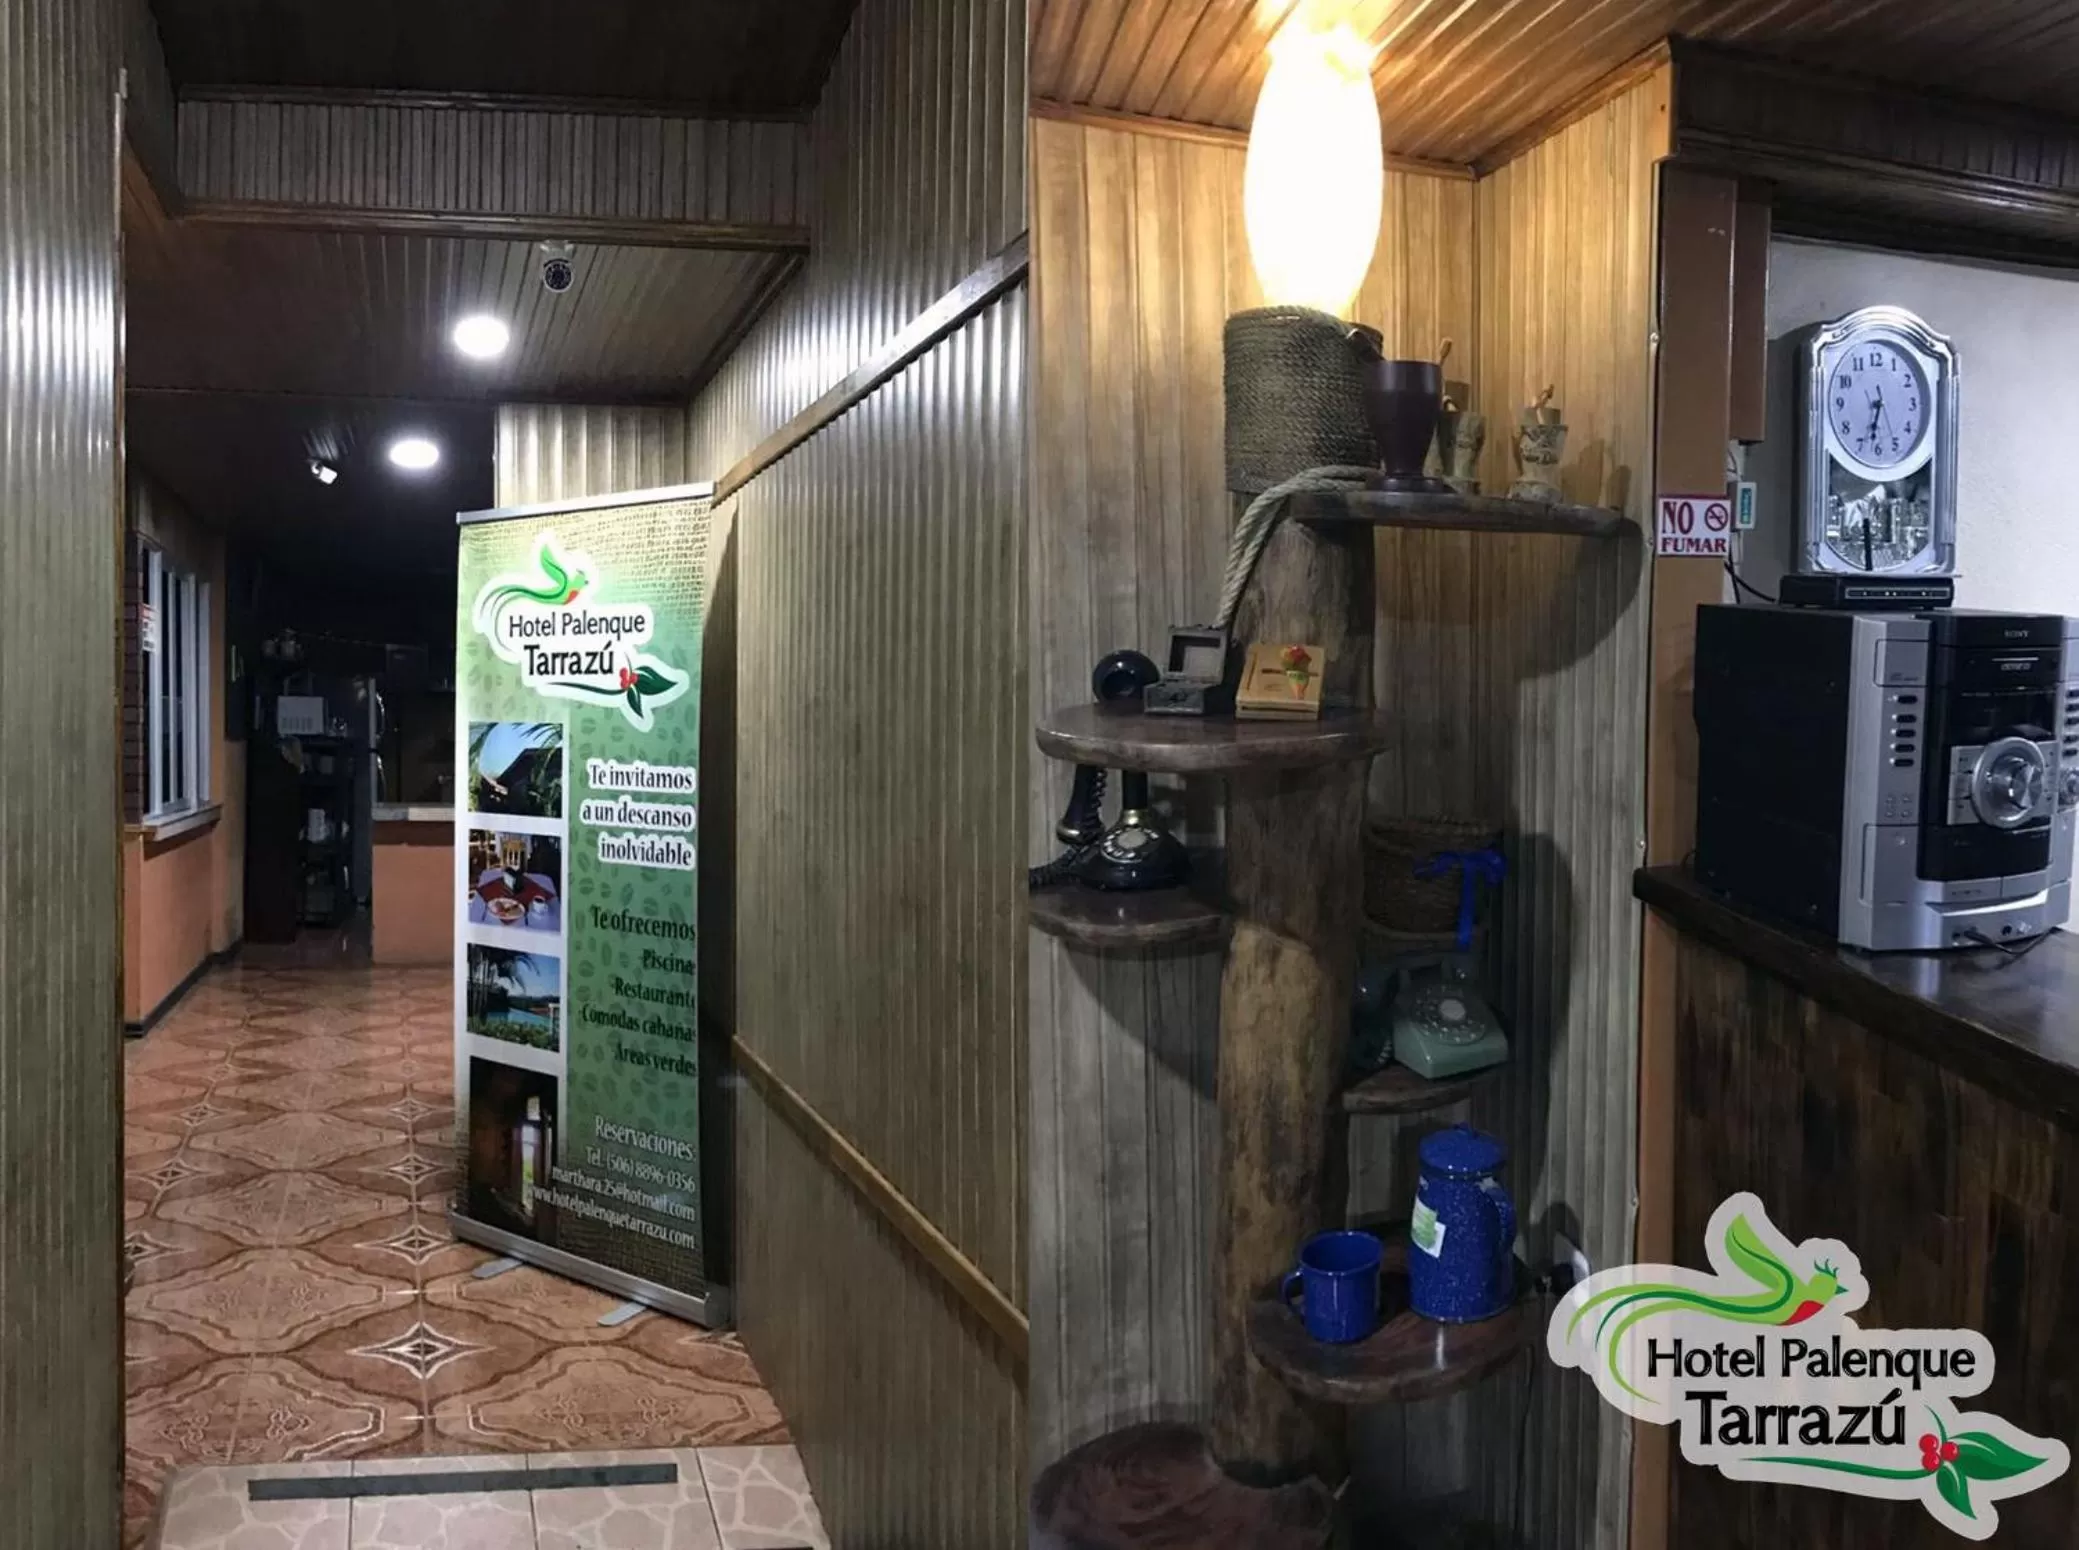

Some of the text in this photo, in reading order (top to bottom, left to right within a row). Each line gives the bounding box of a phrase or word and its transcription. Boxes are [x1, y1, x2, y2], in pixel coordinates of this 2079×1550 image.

[1853, 357, 1864, 372] 11
[1870, 352, 1883, 367] 12
[1891, 358, 1897, 372] 1
[1840, 375, 1852, 389] 10
[1903, 374, 1911, 388] 2
[1836, 397, 1845, 411] 9
[1908, 397, 1917, 411] 3
[1841, 421, 1850, 435] 8
[1903, 421, 1911, 434] 4
[1856, 438, 1864, 452] 7
[1874, 443, 1882, 456] 6
[1891, 437, 1899, 452] 5
[1662, 501, 1694, 535] NO
[1661, 537, 1727, 553] FUMAR
[509, 609, 646, 641] Hotel Palenque
[524, 641, 614, 676] Tarrazú
[590, 764, 693, 790] Te invitamos
[582, 801, 692, 828] a un descanso
[601, 838, 692, 866] inolvidable
[591, 904, 696, 941] Te ofrecemos
[606, 1151, 634, 1178] (506)
[635, 1160, 696, 1195] 8896-0356
[526, 1184, 695, 1249] ww.hotelpalenquetarrazu.com
